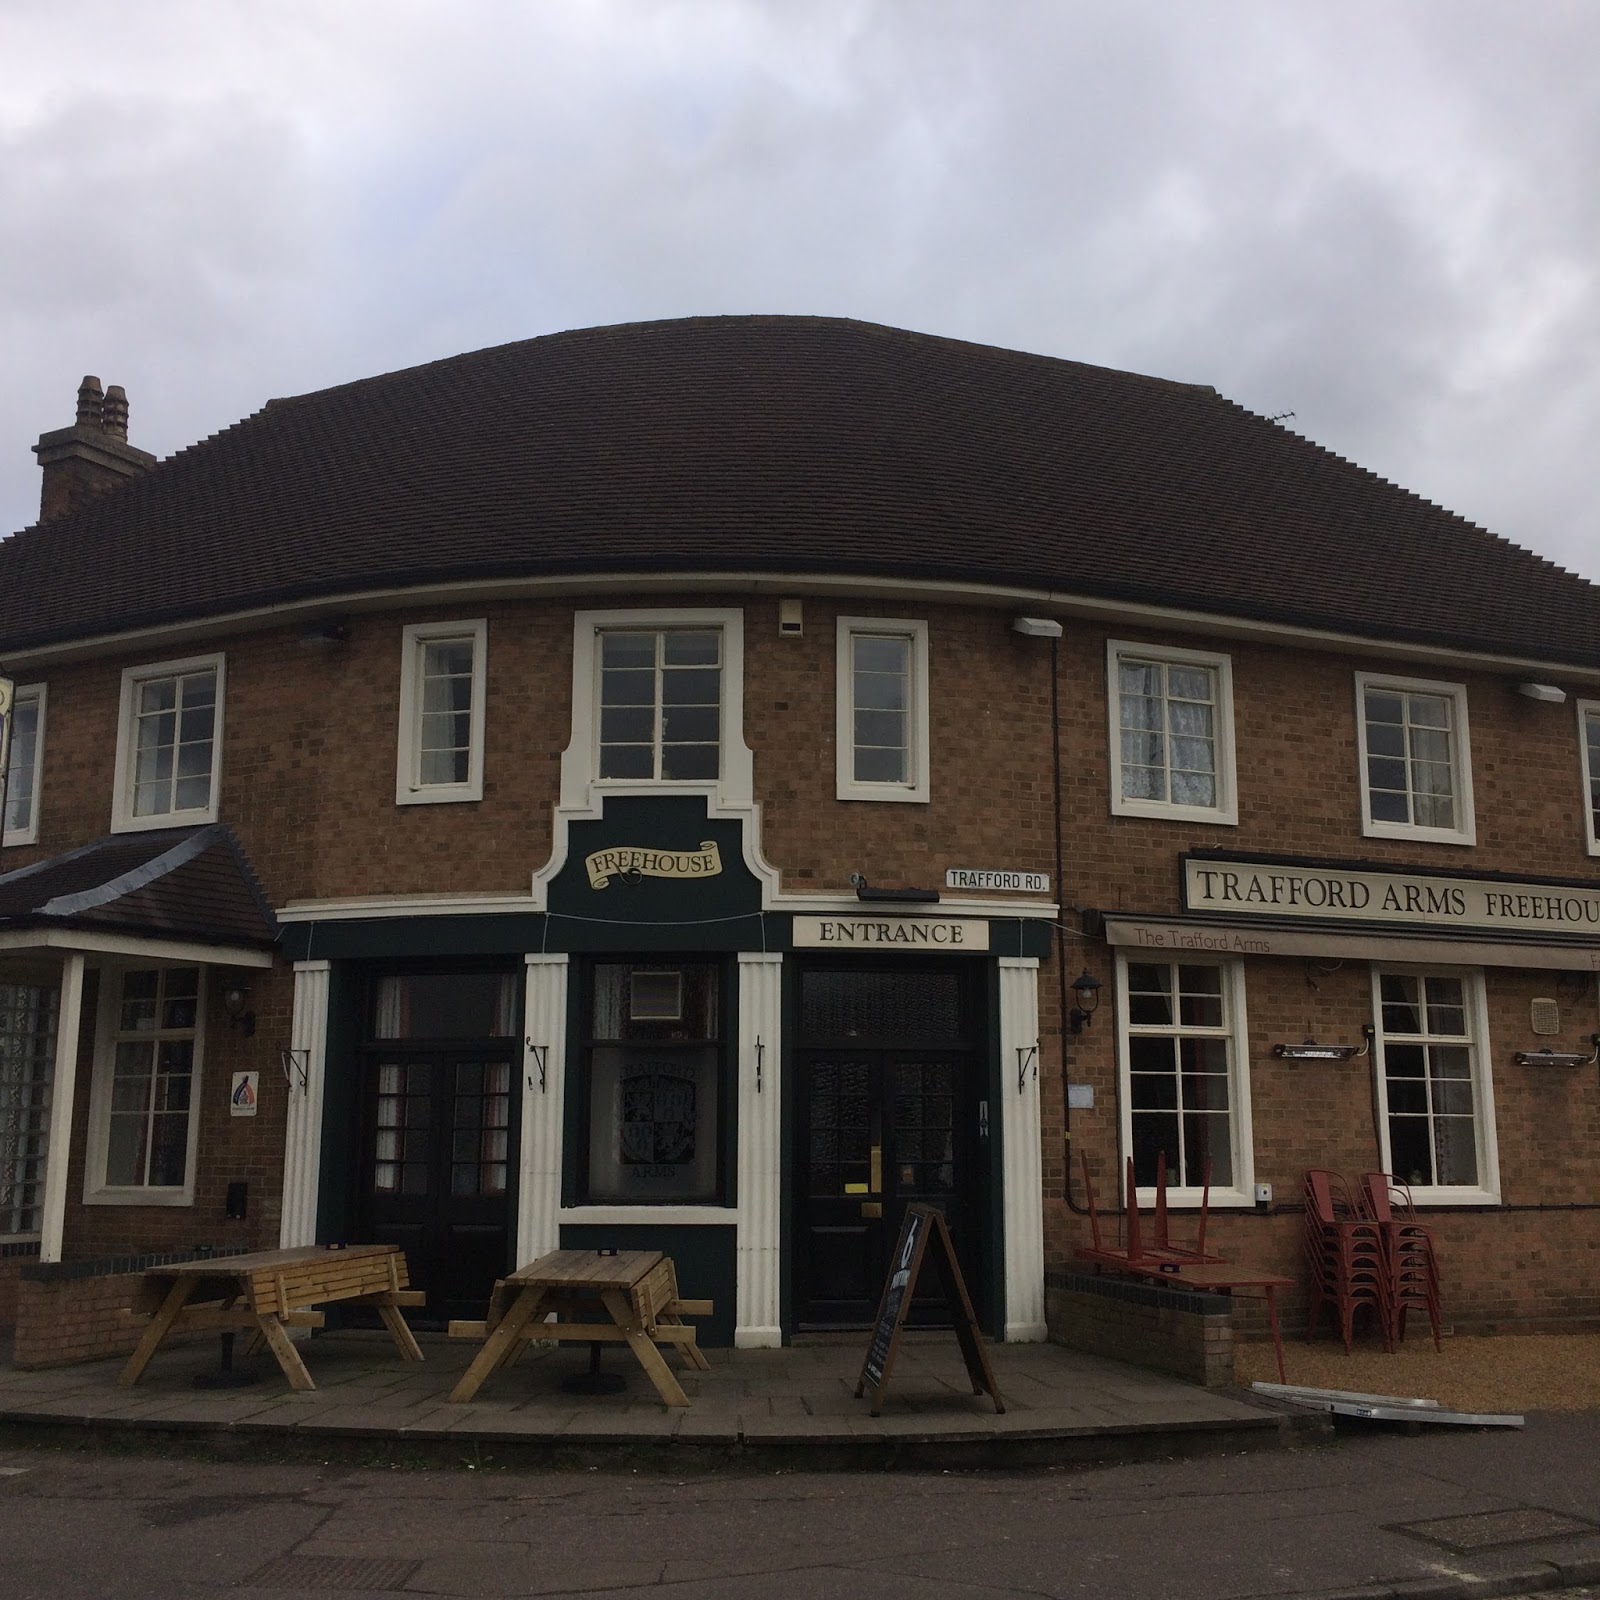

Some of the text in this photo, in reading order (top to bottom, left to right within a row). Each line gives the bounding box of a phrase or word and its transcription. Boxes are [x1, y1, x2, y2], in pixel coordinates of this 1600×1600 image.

[591, 851, 715, 884] FREEHOUSE
[950, 871, 1046, 890] TRAFFORD RD.
[1196, 870, 1370, 909] TRAFFORD
[1381, 883, 1466, 916] ARMS
[819, 922, 963, 944] ENTRANCE
[1134, 928, 1270, 952] The Trafford Arms
